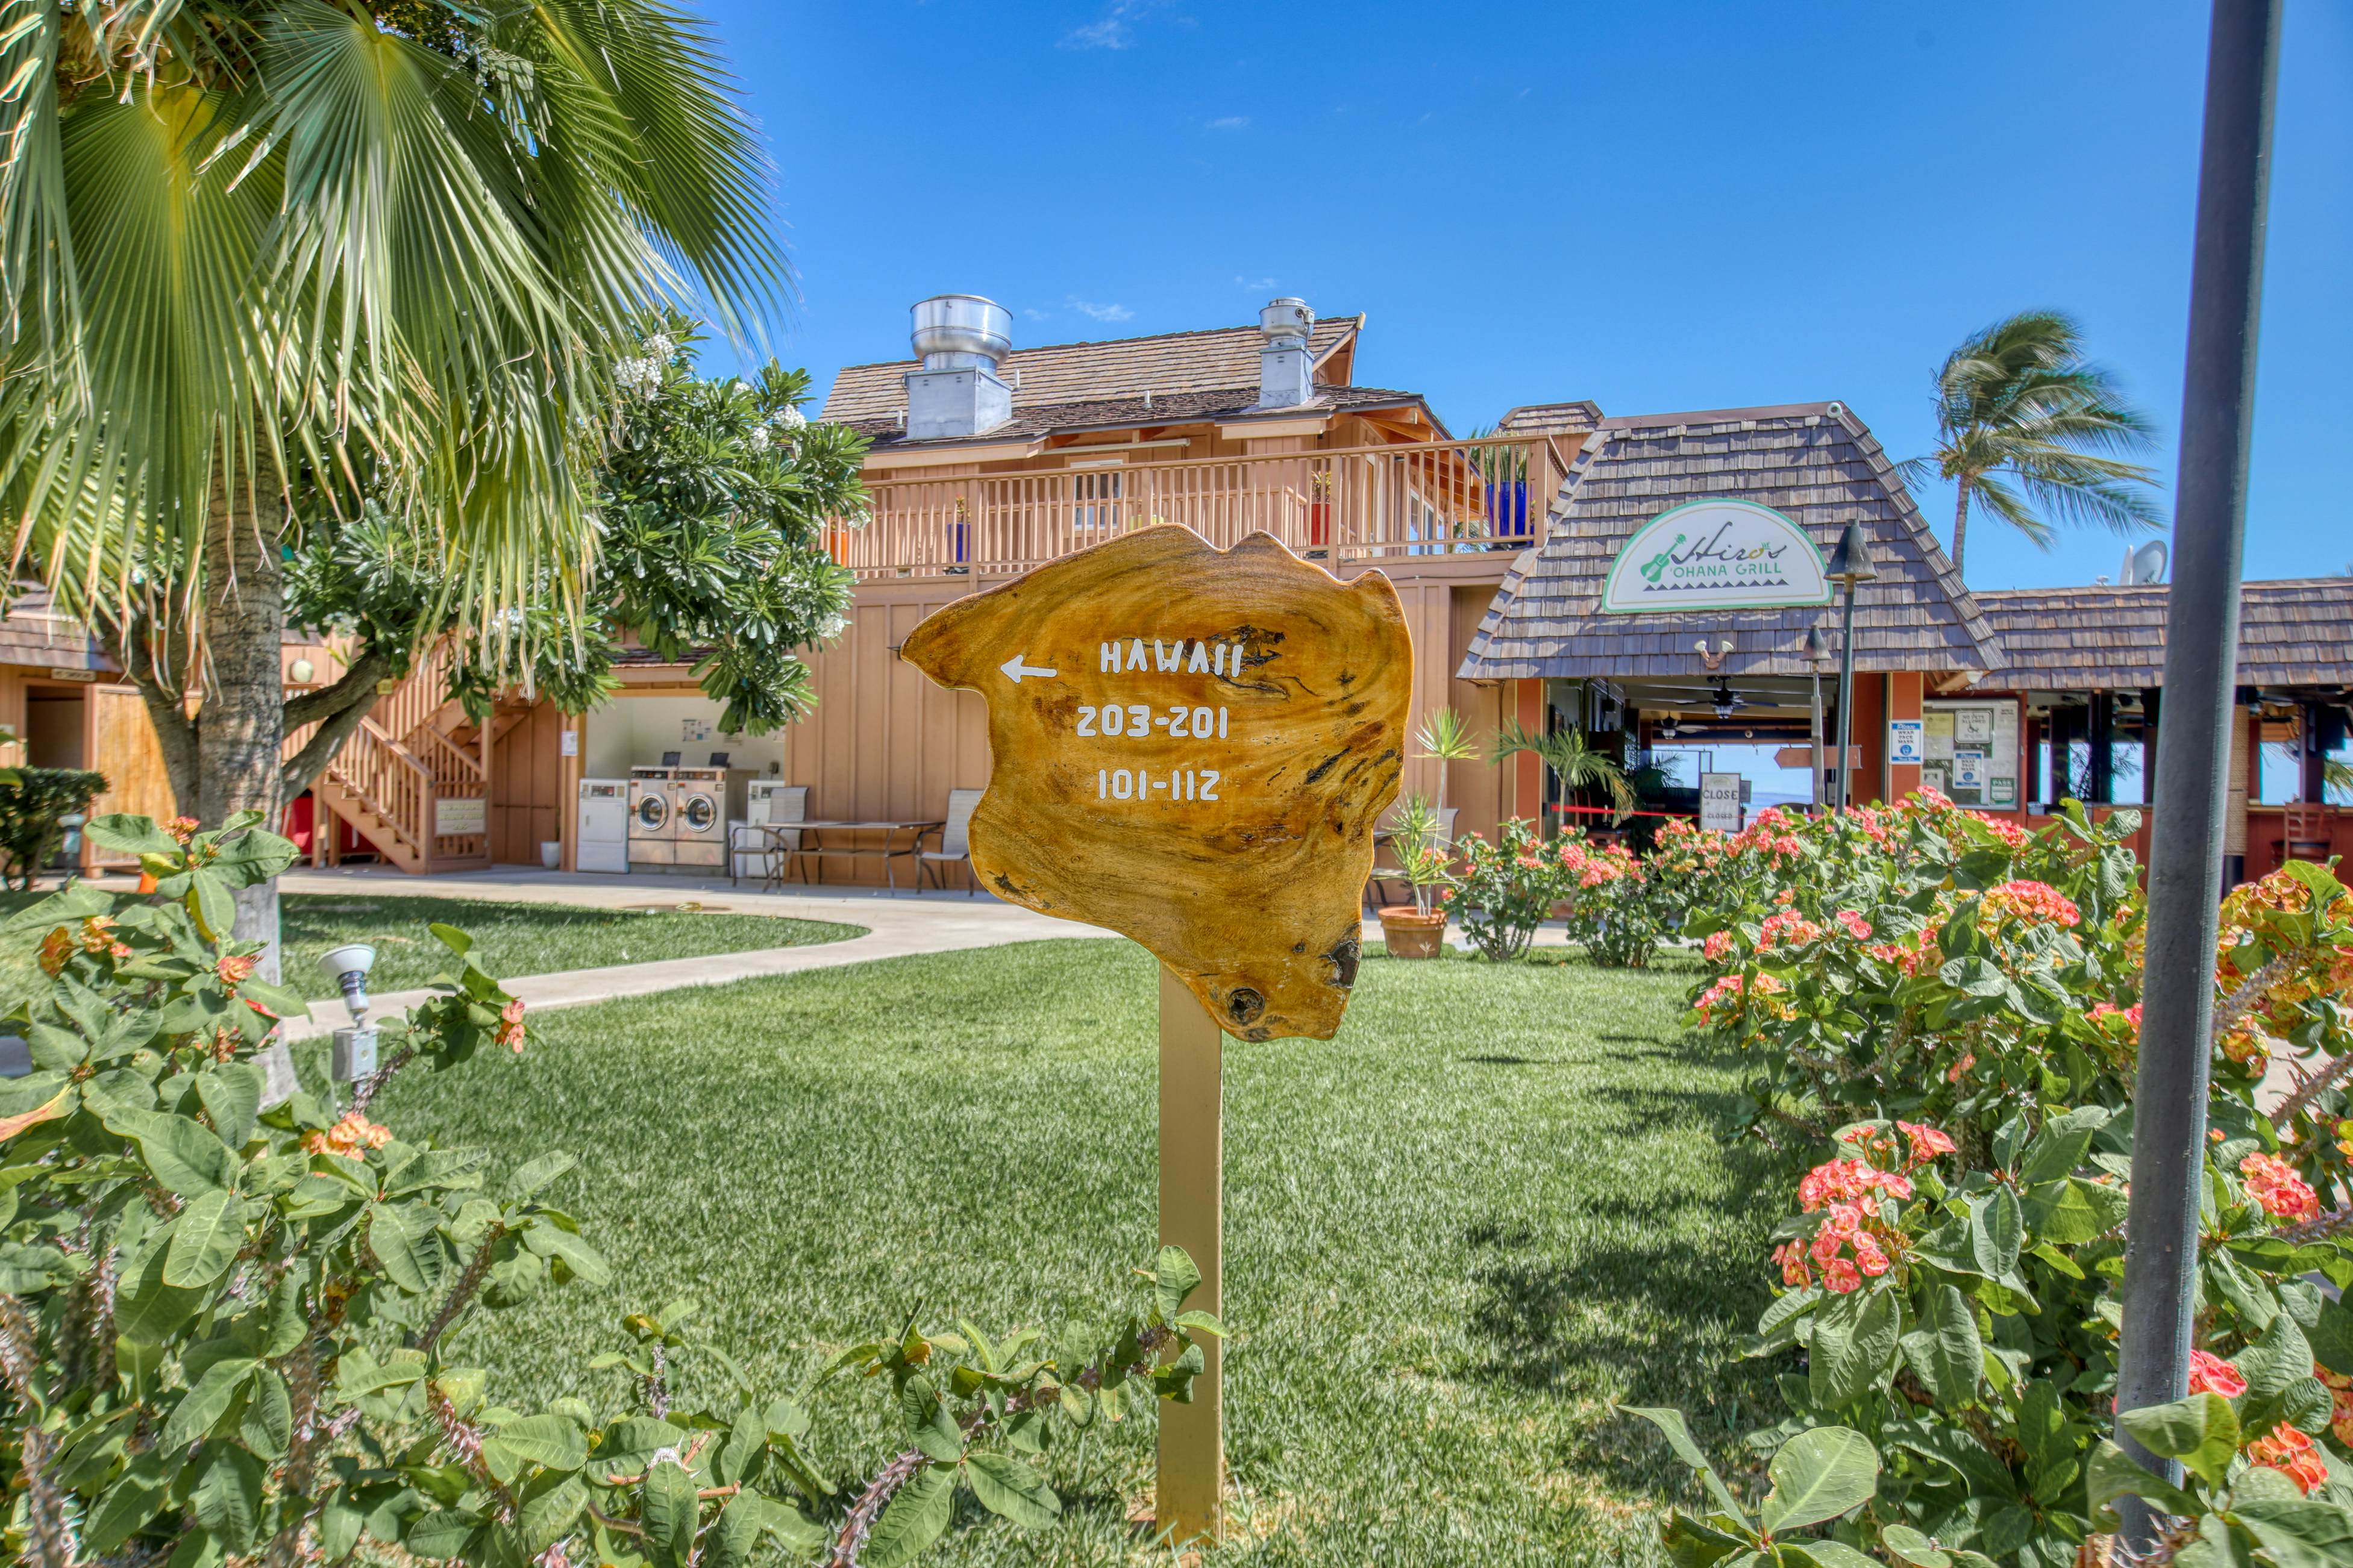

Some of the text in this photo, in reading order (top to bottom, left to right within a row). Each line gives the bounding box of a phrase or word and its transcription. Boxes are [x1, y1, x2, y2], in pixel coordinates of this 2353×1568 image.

[1735, 562, 1782, 575] GRILL
[1100, 638, 1244, 677] HAWAII
[1077, 704, 1228, 739] 203-201
[1099, 769, 1220, 801] 101-112
[1703, 790, 1738, 800] CLOSE
